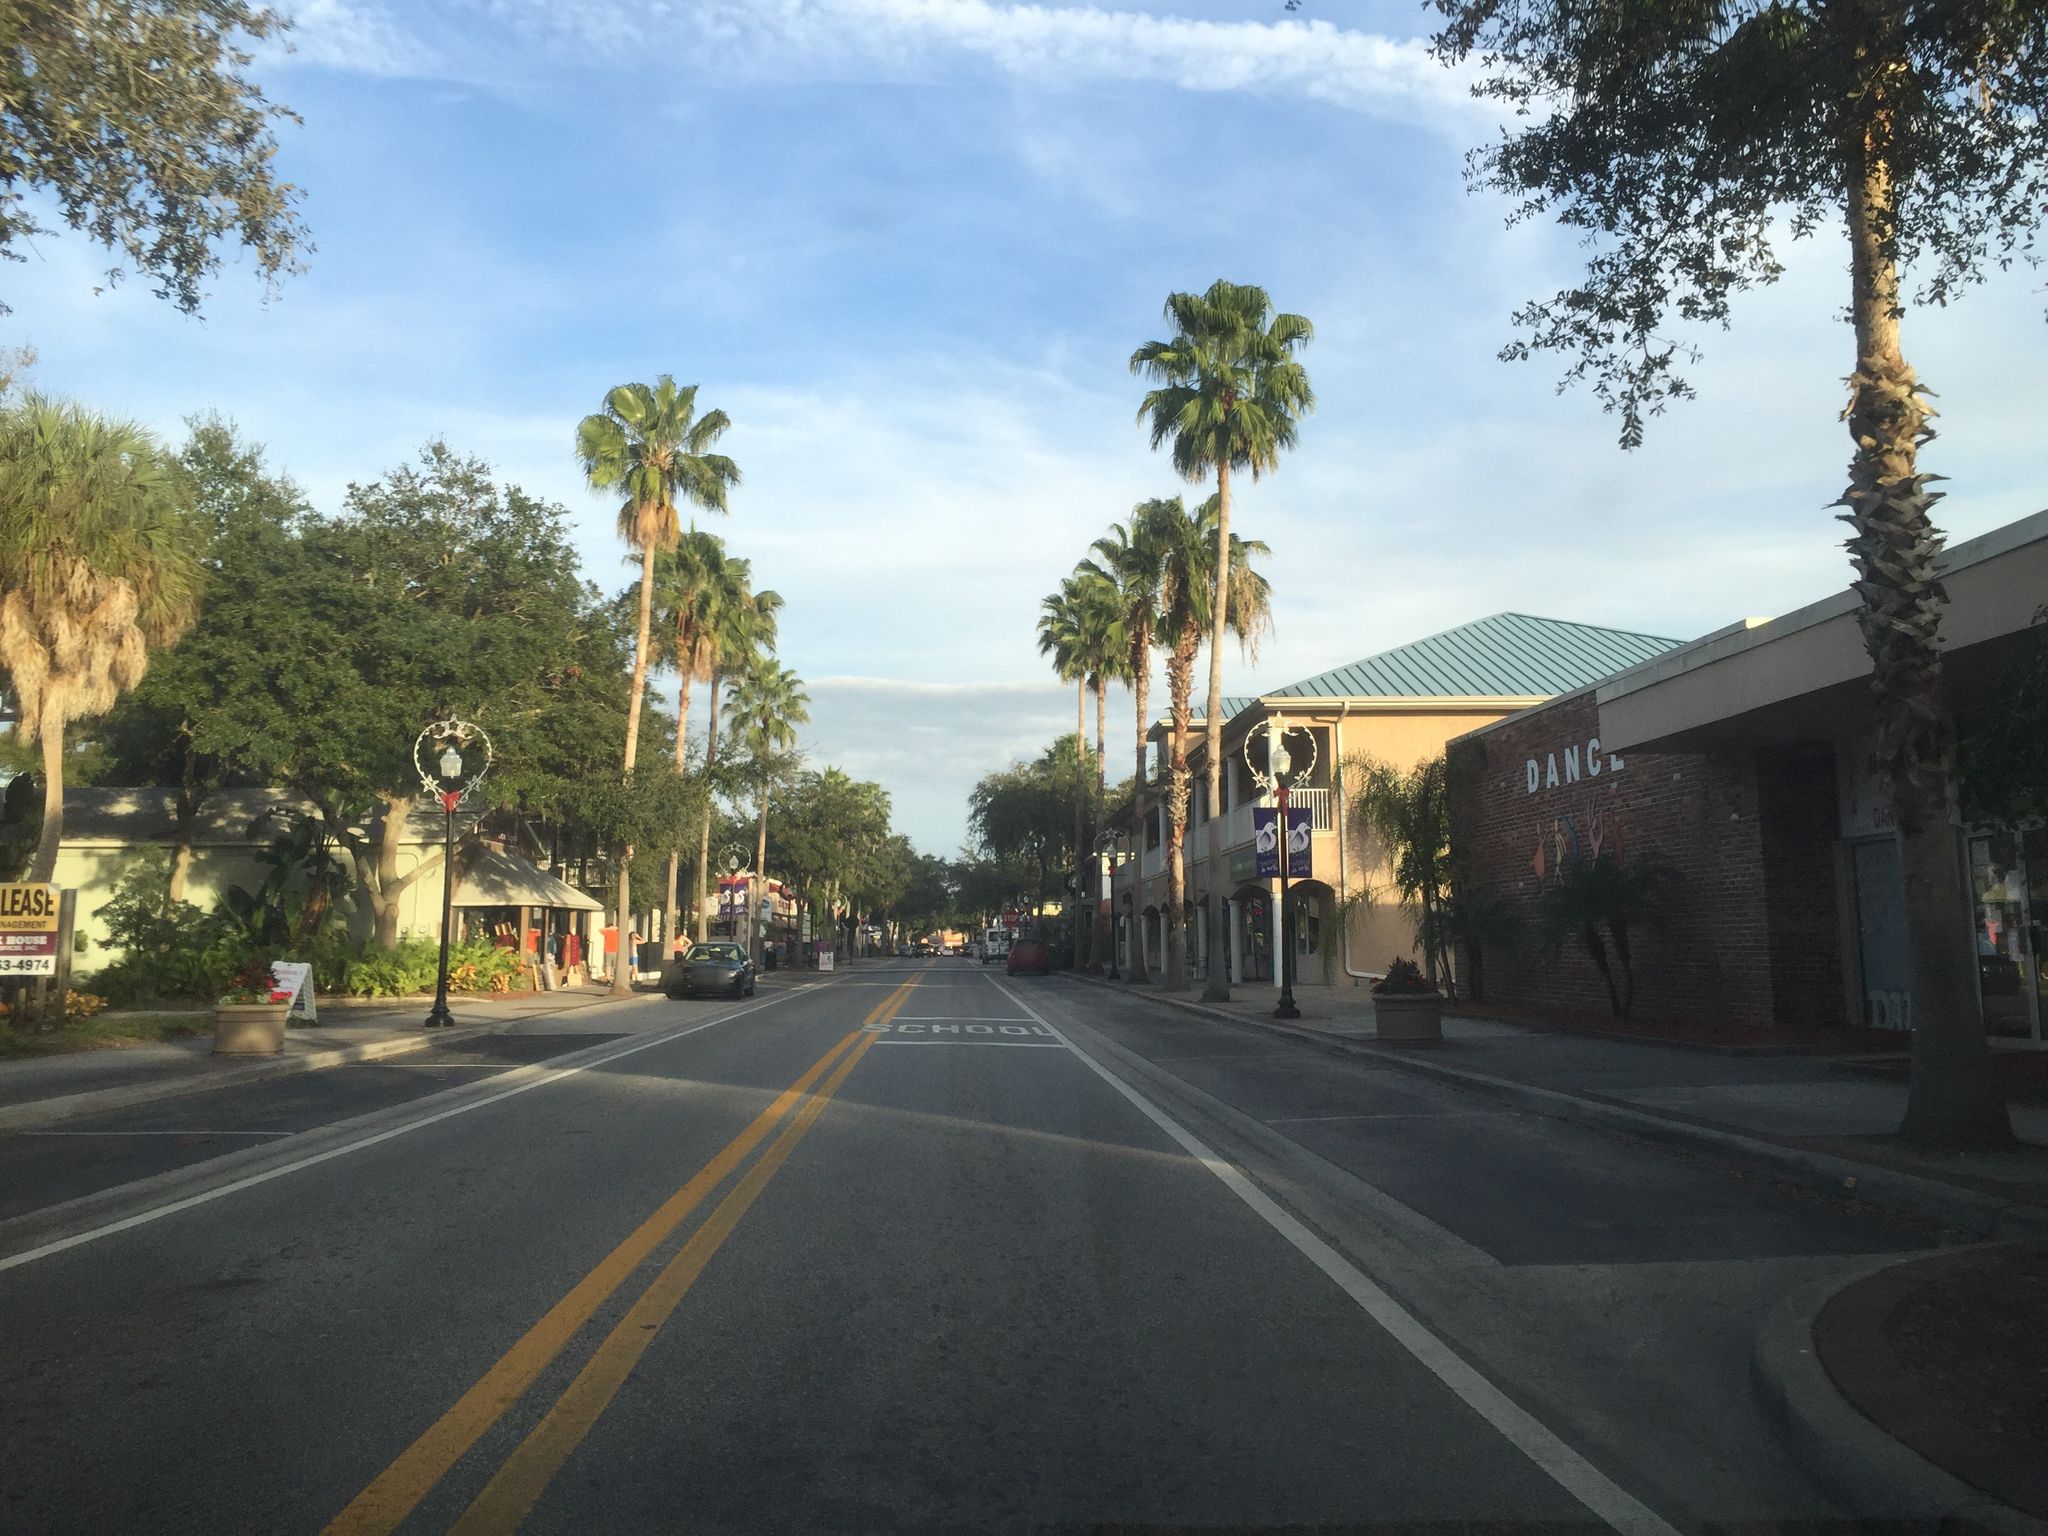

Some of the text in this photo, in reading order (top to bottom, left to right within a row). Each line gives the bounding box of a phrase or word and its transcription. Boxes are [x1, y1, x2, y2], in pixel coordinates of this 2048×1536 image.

[0, 888, 54, 916] LEASE
[1003, 914, 1018, 922] STOP
[860, 1022, 1054, 1036] SCHOOL
